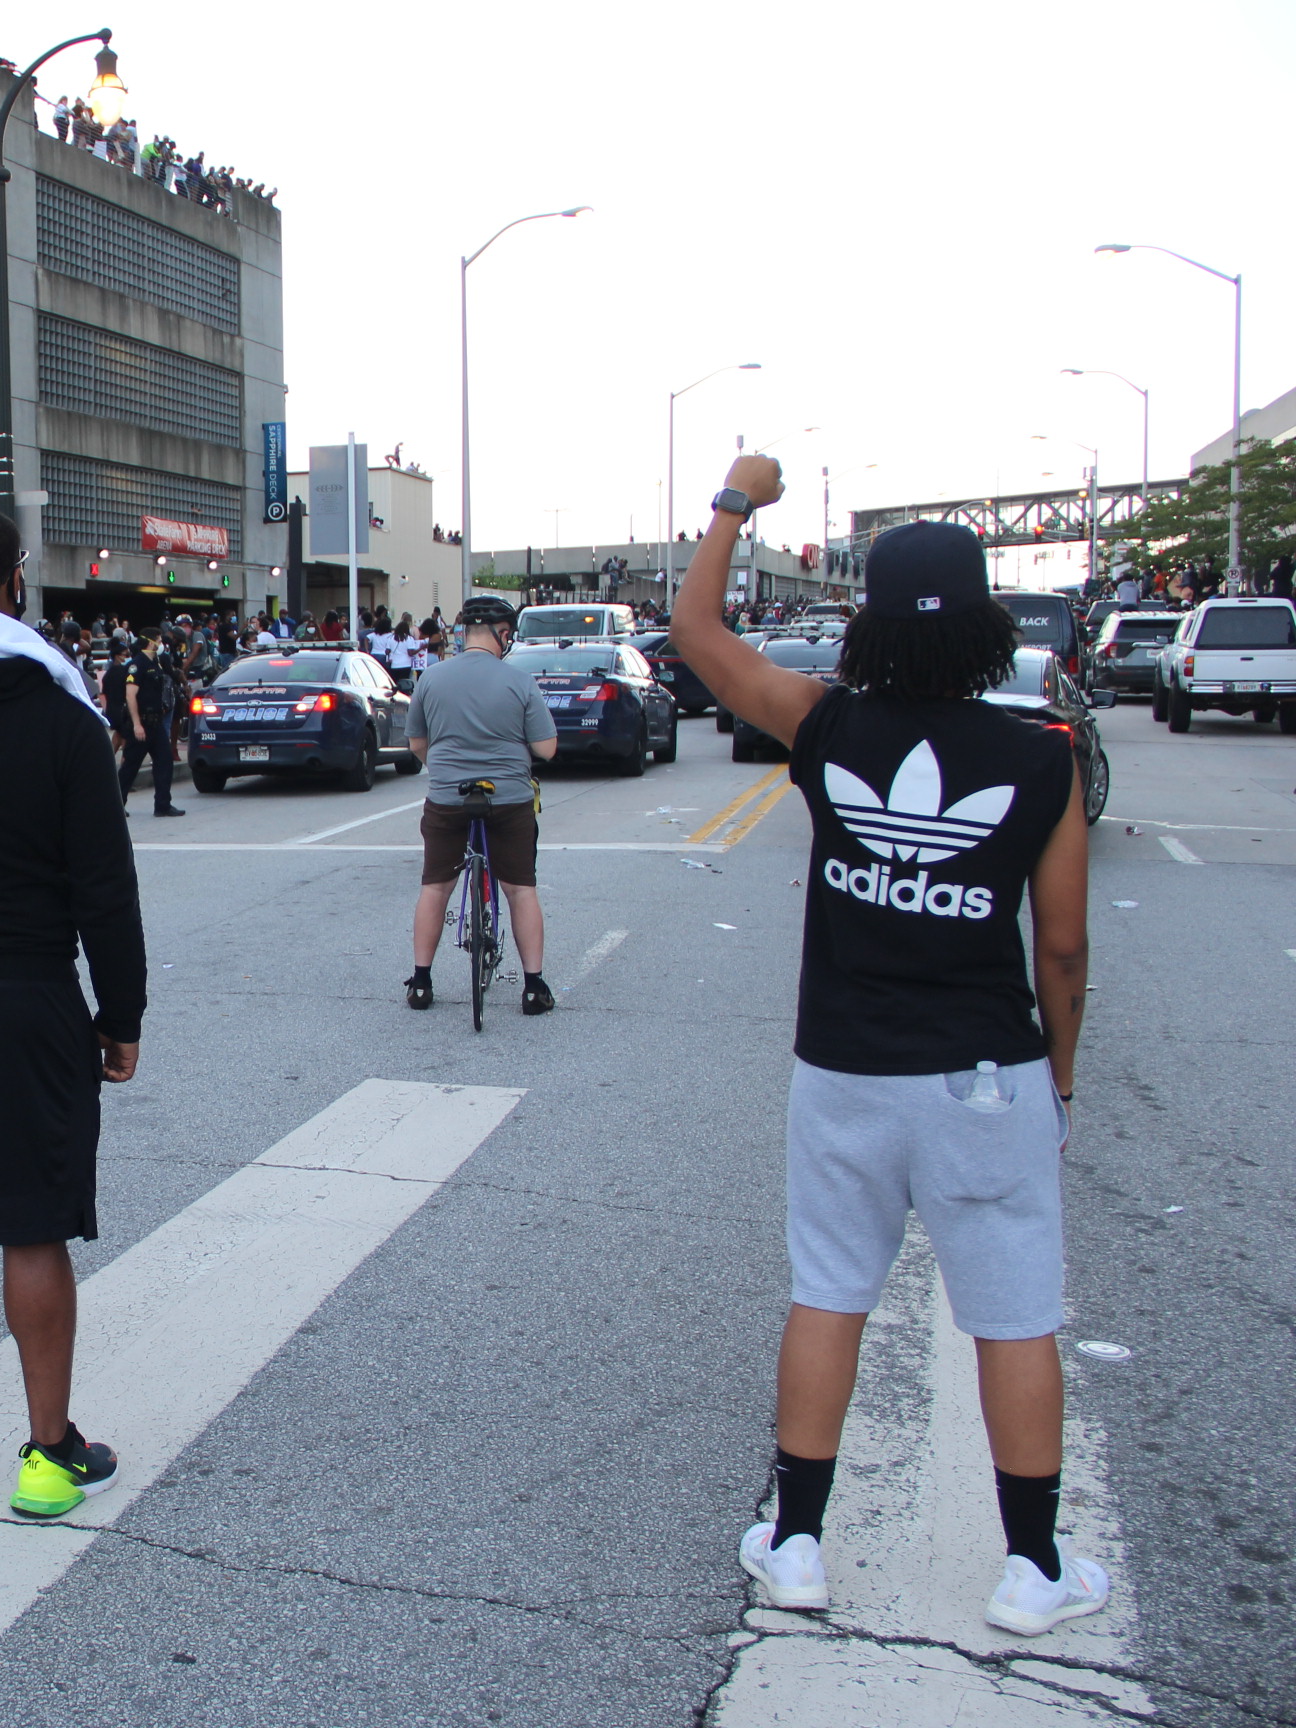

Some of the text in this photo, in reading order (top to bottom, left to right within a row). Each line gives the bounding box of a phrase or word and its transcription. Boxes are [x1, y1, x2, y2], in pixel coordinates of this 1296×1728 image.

[269, 425, 277, 471] SAPPHIRE
[1019, 617, 1049, 626] BACK
[228, 687, 287, 695] ATLANTA
[222, 708, 288, 722] POLICE
[824, 857, 993, 920] adidas
